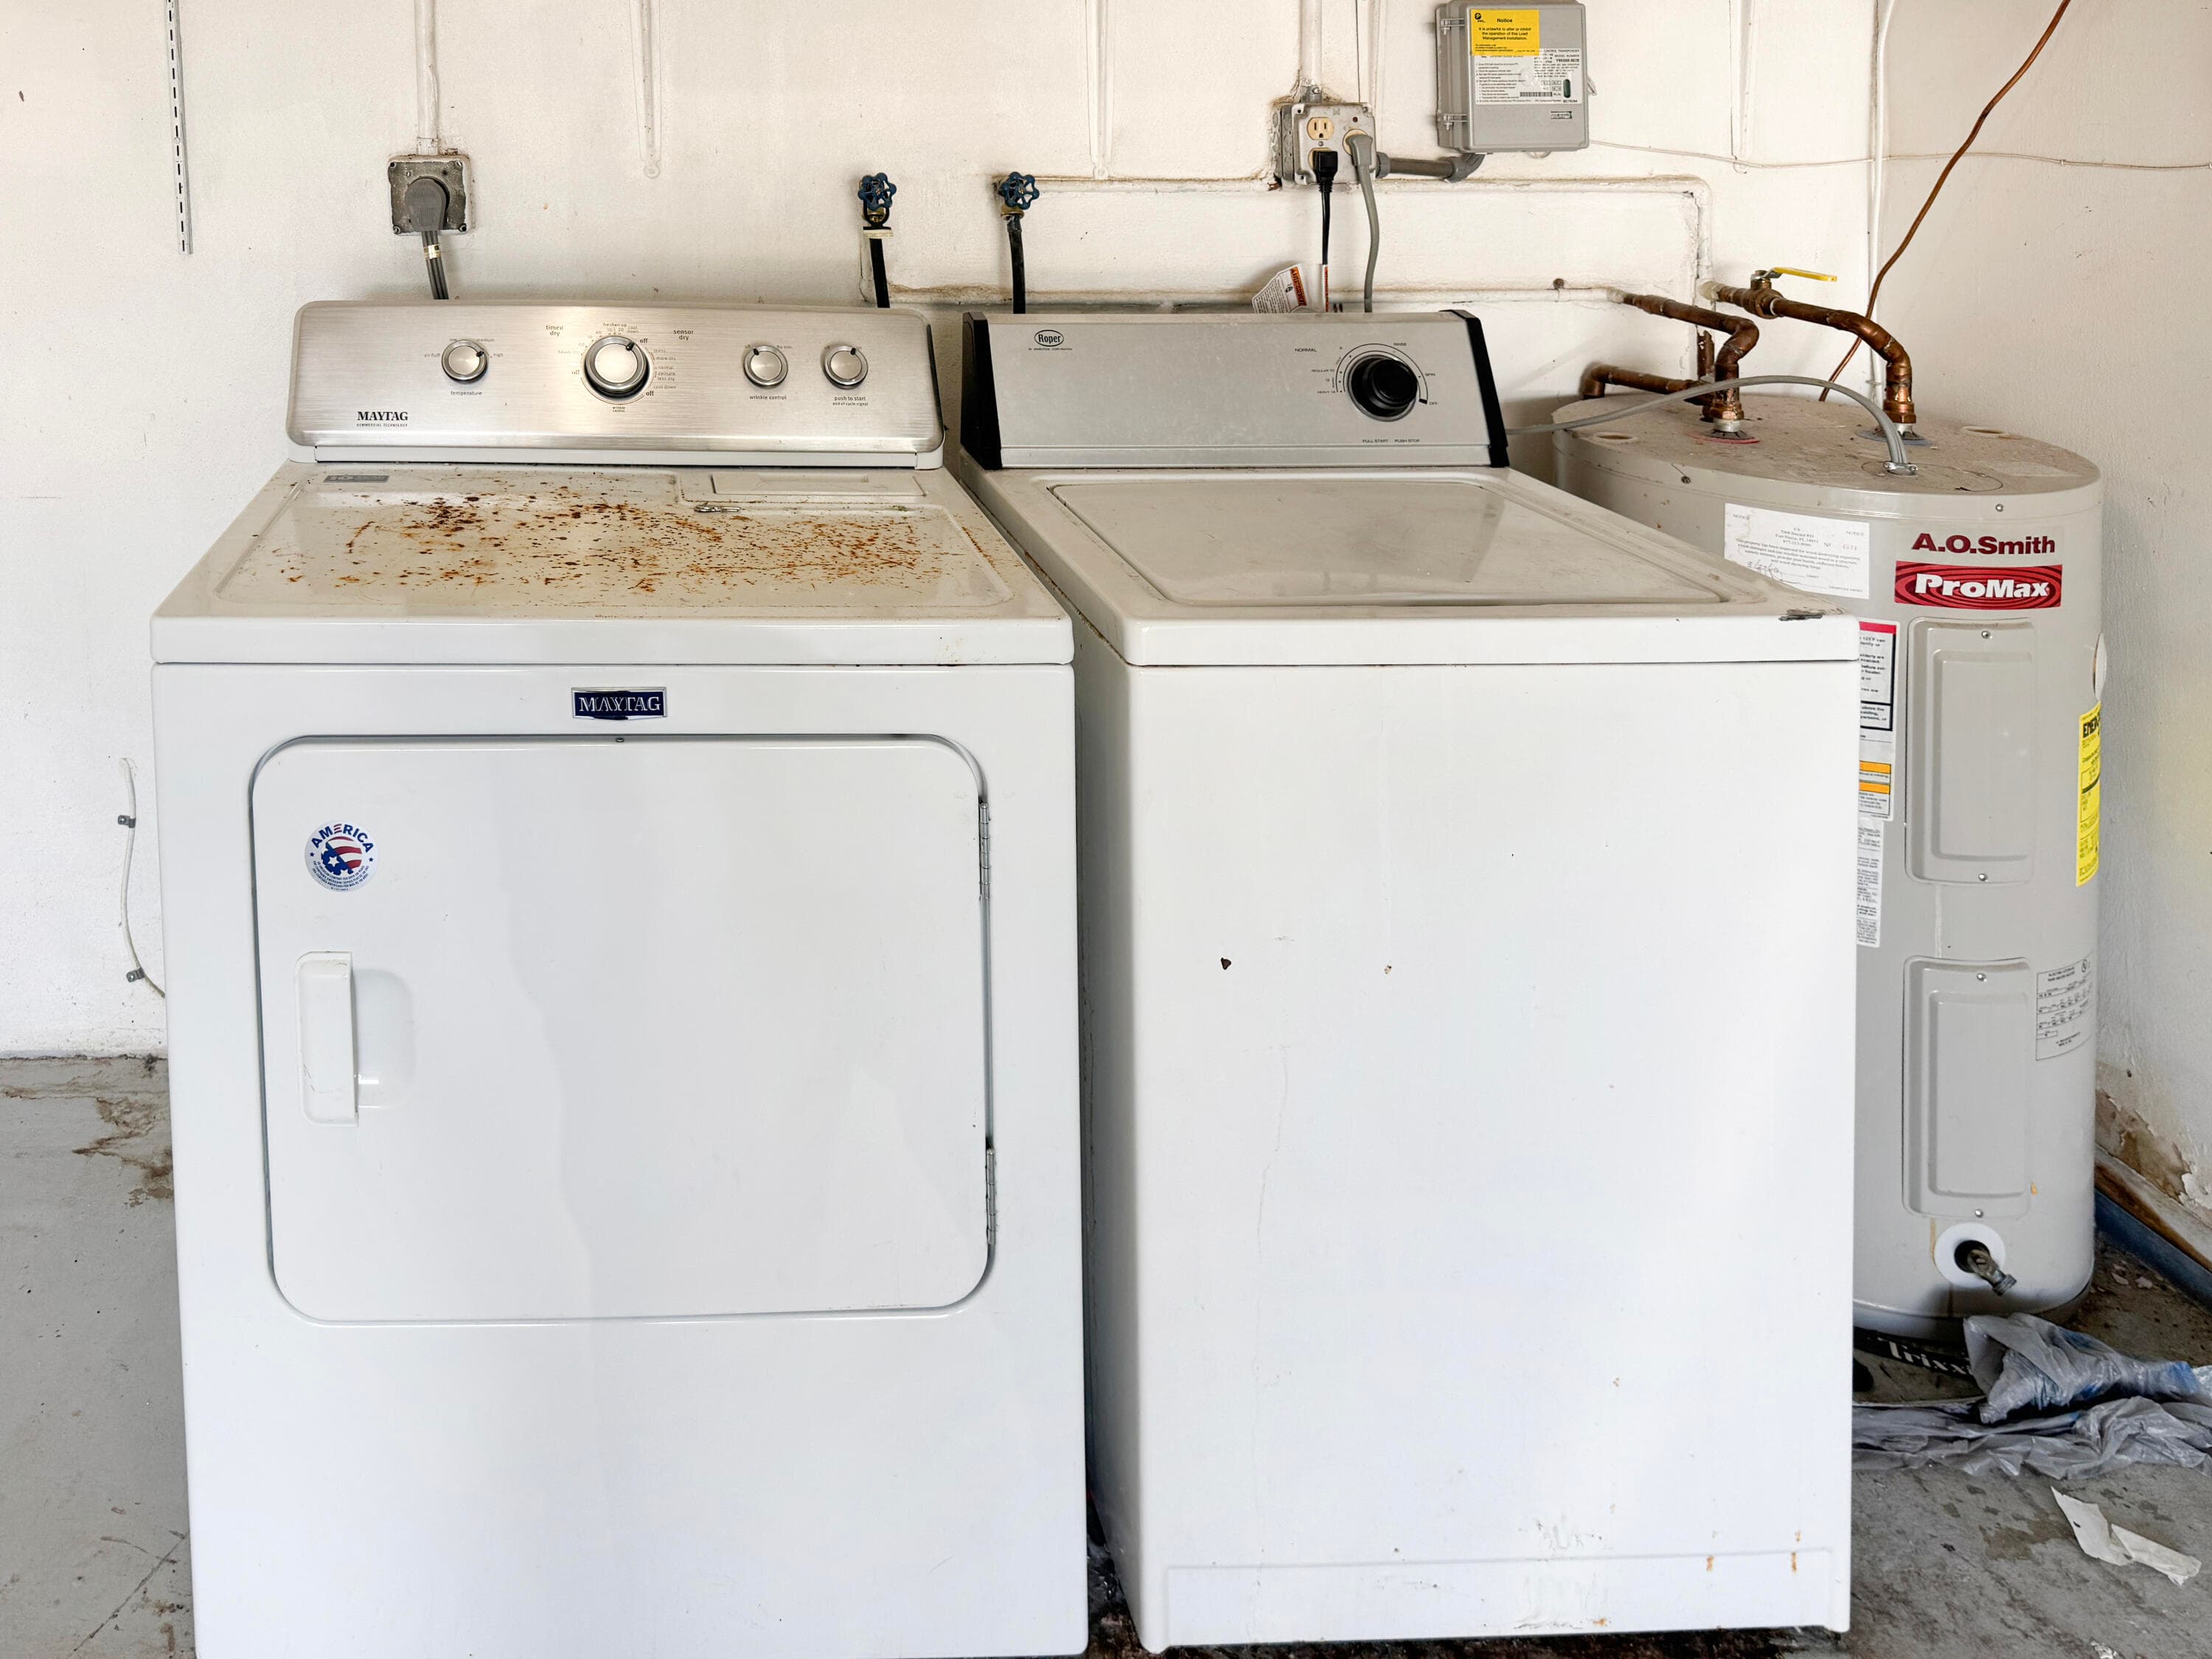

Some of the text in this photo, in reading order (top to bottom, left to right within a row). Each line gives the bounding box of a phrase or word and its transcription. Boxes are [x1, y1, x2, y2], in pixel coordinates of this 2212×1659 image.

[1038, 333, 1061, 344] Roper
[357, 411, 408, 421] MAYTAG
[1915, 573, 2049, 598] ProMax
[579, 696, 661, 712] MAYTAG
[311, 824, 374, 852] AMERICA
[1877, 1337, 1972, 1376] Trixx
